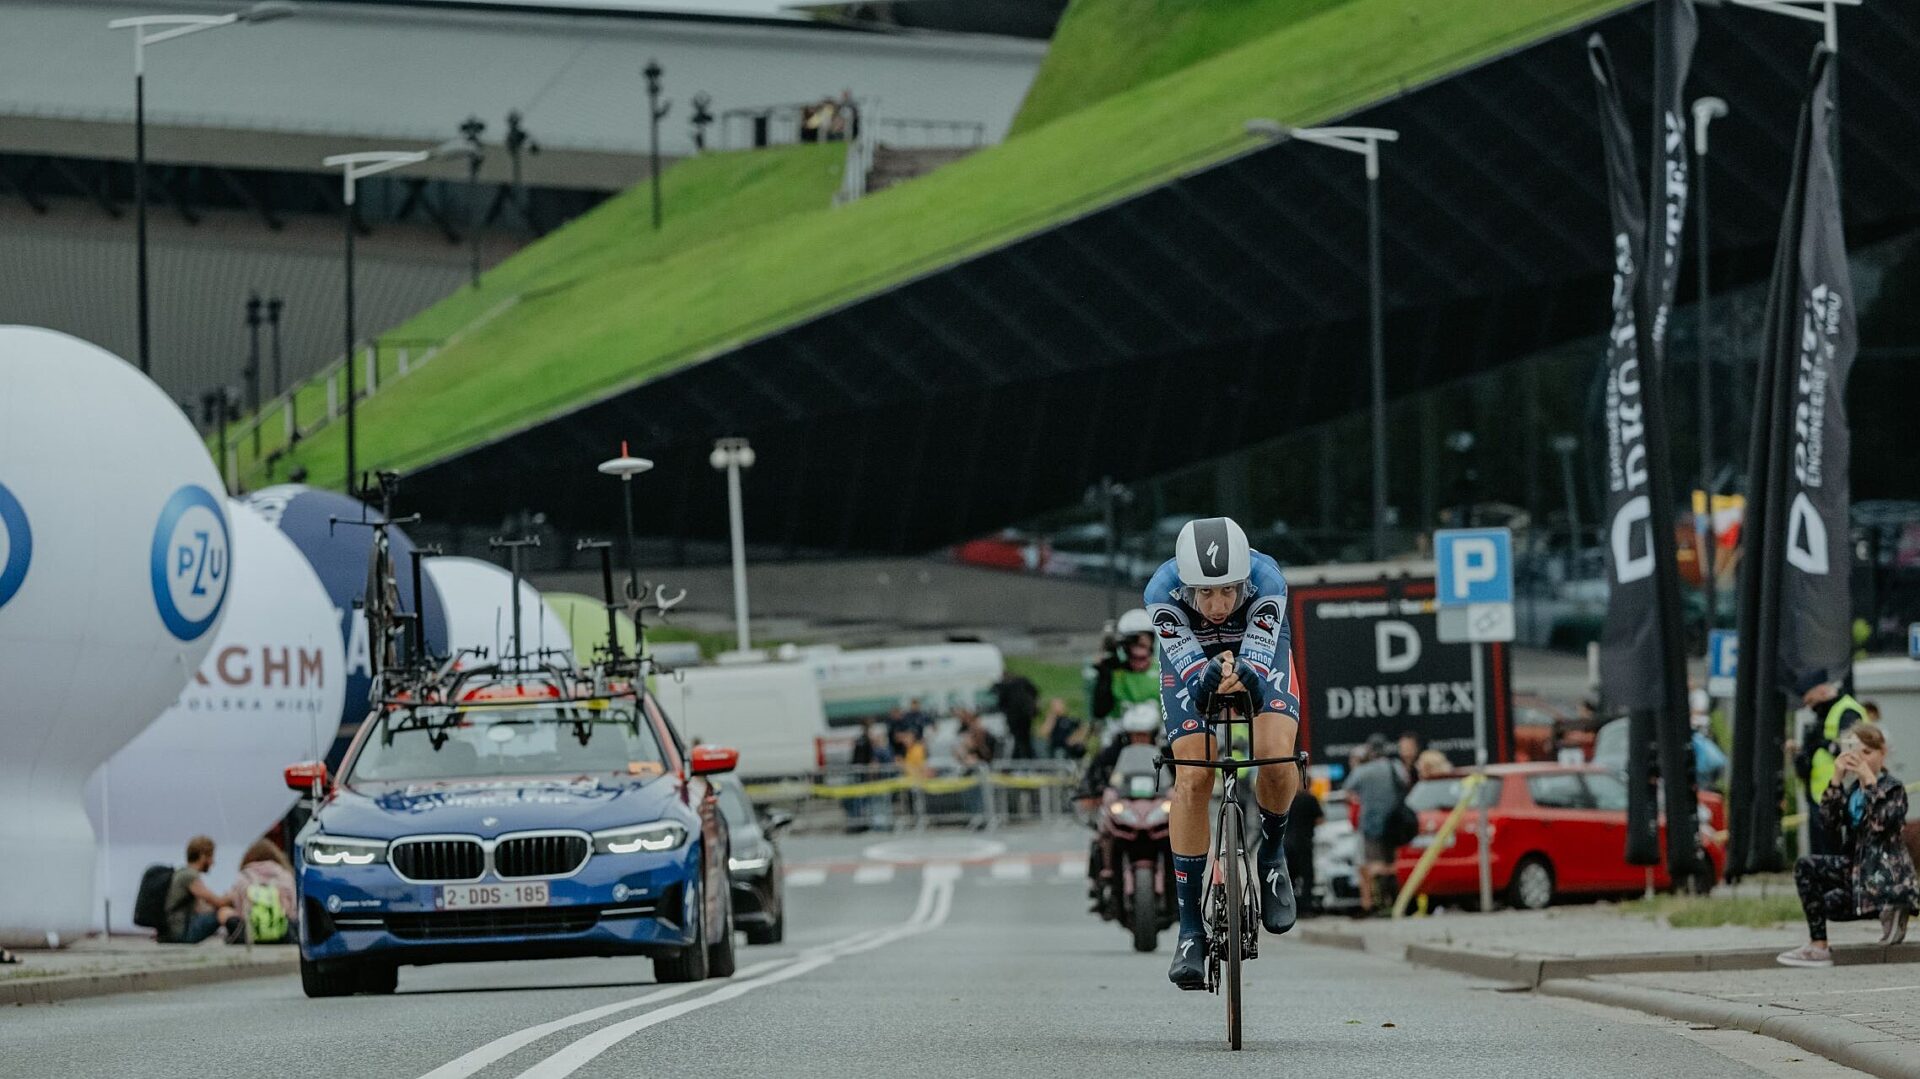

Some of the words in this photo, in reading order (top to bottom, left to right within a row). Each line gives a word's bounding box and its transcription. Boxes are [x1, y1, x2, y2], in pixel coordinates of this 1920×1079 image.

[177, 531, 223, 596] PZU
[1453, 538, 1497, 598] P
[1326, 682, 1474, 720] DRUTEX
